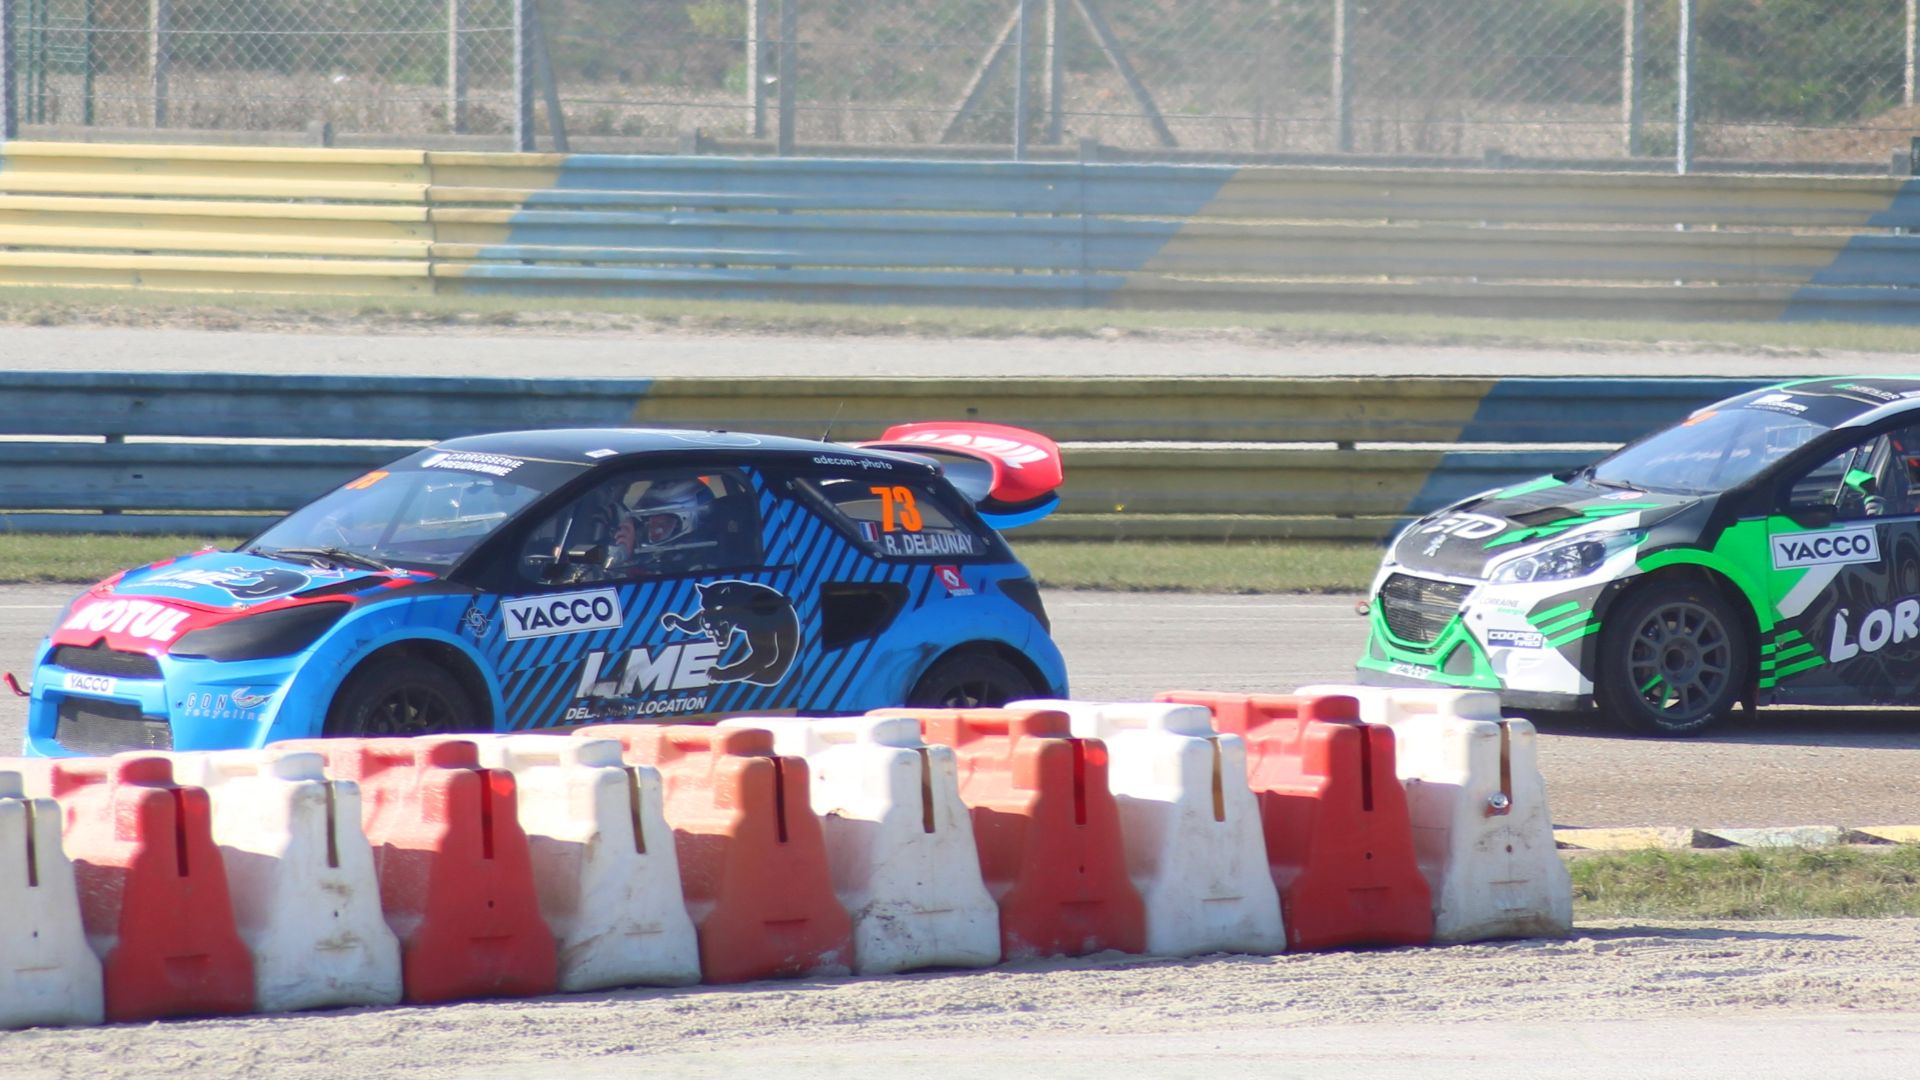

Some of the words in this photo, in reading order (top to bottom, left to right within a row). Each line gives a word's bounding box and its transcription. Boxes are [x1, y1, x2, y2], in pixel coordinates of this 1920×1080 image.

[446, 453, 525, 468] CARROSSERIE
[813, 456, 893, 470] adecom-photo
[870, 486, 923, 532] 73
[885, 535, 902, 554] R.
[904, 535, 974, 555] DELAUNAY
[1779, 534, 1871, 561] YACCO
[64, 600, 190, 641] MOTUL
[511, 596, 613, 631] YACCO
[1489, 631, 1543, 642] COOPER
[1514, 640, 1542, 648] TIRES
[575, 642, 721, 699] LME
[69, 675, 110, 692] YACCO
[637, 697, 708, 715] LOCATION
